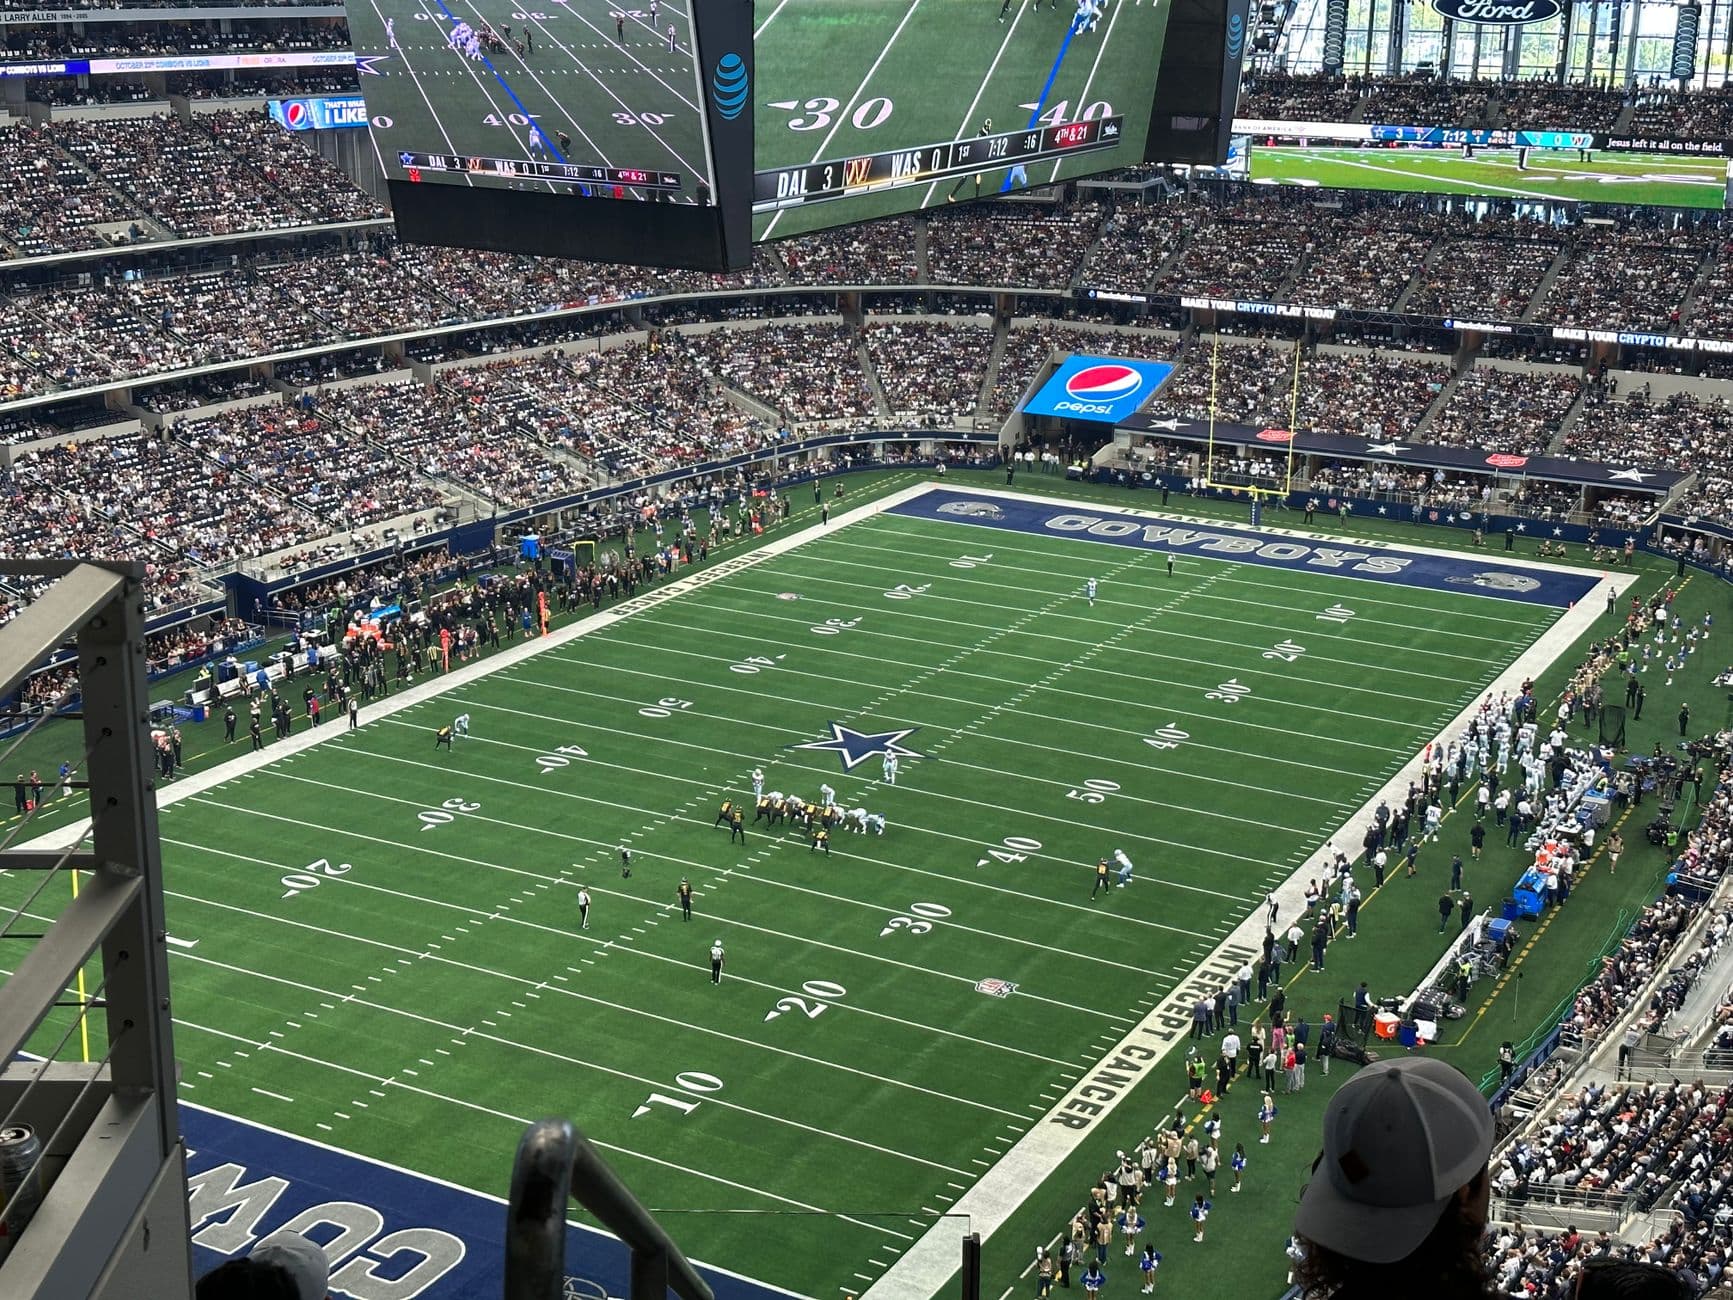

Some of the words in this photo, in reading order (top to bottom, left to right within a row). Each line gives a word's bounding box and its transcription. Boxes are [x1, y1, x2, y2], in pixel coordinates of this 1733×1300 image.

[4, 13, 30, 21] LARRY
[32, 13, 57, 21] ALLEN
[1457, 0, 1535, 19] Ford
[325, 107, 330, 124] I
[333, 107, 368, 124] LIKE
[788, 97, 893, 131] 30
[1054, 129, 1069, 144] 4TH
[1069, 128, 1076, 142] &
[1077, 126, 1088, 140] 21
[1395, 127, 1404, 140] 3
[1442, 130, 1468, 142] 7:12
[1554, 134, 1562, 146] 0
[1606, 137, 1630, 148] Jesus
[1631, 138, 1648, 148] left
[1649, 139, 1657, 149] it
[1658, 140, 1670, 149] all
[1671, 142, 1683, 150] on
[1685, 141, 1700, 151] the
[1701, 142, 1724, 152] field.
[958, 145, 970, 161] 1ST
[988, 138, 1008, 158] 7:12
[428, 155, 448, 168] DAL
[454, 157, 461, 169] 3
[495, 160, 516, 175] WAS
[522, 163, 529, 175] 0
[563, 166, 579, 177] 7:12
[891, 151, 922, 178] WAS
[931, 149, 941, 171] 0
[638, 172, 647, 181] 21
[777, 169, 808, 198] DAL
[822, 165, 833, 190] 3
[1181, 297, 1209, 309] MAKE
[1210, 299, 1236, 311] YOUR
[1237, 300, 1276, 314] CRYPTO
[1277, 304, 1303, 317] PLAY
[1304, 307, 1337, 320] TODAY
[1552, 327, 1586, 340] MAKE
[1587, 330, 1618, 343] YOUR
[1619, 333, 1664, 346] CRYPTO
[1664, 336, 1697, 350] PLAY
[1698, 339, 1733, 352] TODAY
[1054, 402, 1114, 415] pepsi
[1158, 513, 1235, 528] TAKES
[1308, 534, 1340, 542] OF
[1354, 539, 1389, 548] US
[1045, 514, 1413, 574] COWBOYS
[683, 550, 773, 587] INTERCEPT
[607, 586, 686, 616] CANCER
[883, 583, 925, 600] 20
[810, 618, 856, 636] 30
[1262, 643, 1306, 662] 20
[729, 655, 775, 674] 40
[1204, 683, 1251, 703] 30
[638, 697, 694, 718] 50
[1142, 728, 1190, 750] 40
[535, 744, 589, 768] 40
[1066, 778, 1121, 804] 50
[416, 797, 481, 825] 30
[987, 836, 1042, 864] 40
[280, 858, 352, 890] 20
[886, 902, 952, 935] 30
[776, 980, 847, 1019] 20
[1142, 944, 1258, 1042] INTERCEPT
[646, 1071, 724, 1115] 10
[1050, 1044, 1156, 1130] CANCER
